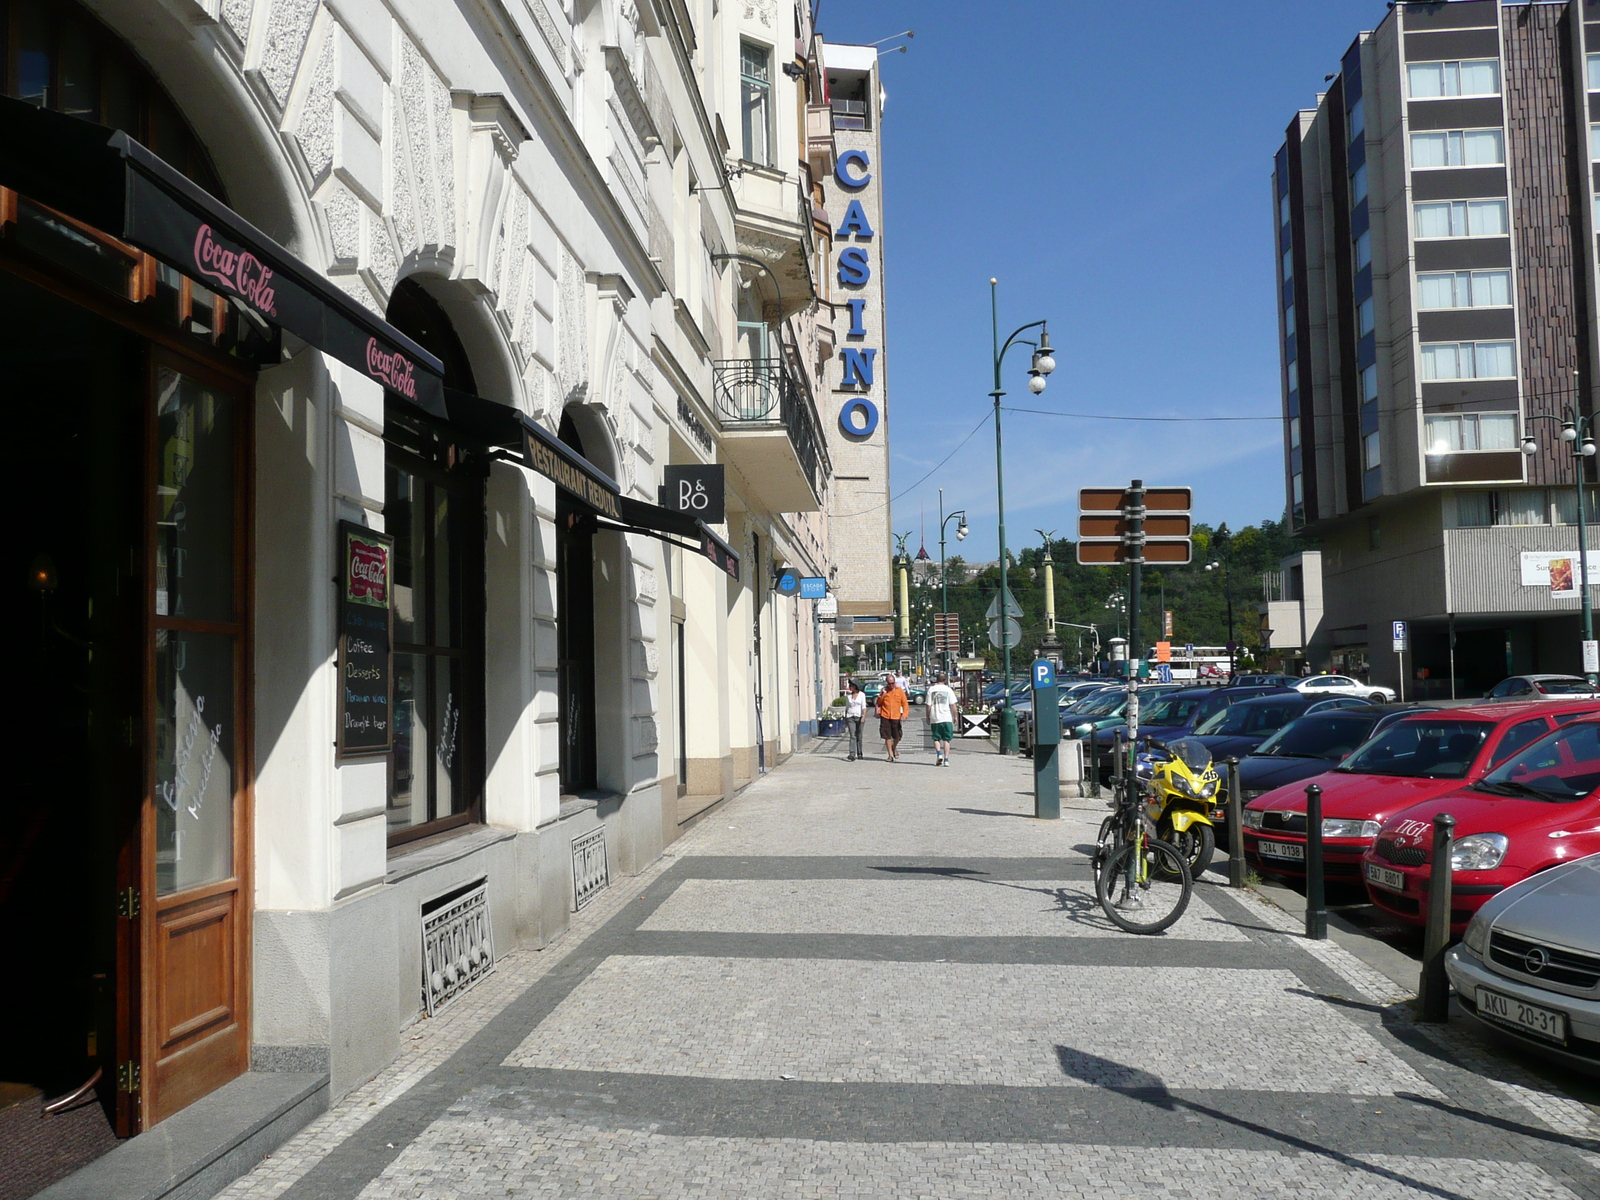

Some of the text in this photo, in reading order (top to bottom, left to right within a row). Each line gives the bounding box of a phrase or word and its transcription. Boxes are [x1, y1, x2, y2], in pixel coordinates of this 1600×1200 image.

[194, 224, 276, 314] Coca-Cola
[836, 150, 879, 436] CASINO
[366, 337, 416, 399] Coca-Cola
[528, 435, 620, 518] RESTAURANT REDUTA
[347, 635, 375, 654] Coffee
[346, 661, 381, 681] Desserts
[1038, 666, 1049, 681] P
[163, 695, 205, 811] Espresso
[188, 723, 222, 820] Macchiato
[1203, 770, 1217, 781] 46
[1395, 819, 1432, 837] TIGI
[1263, 843, 1300, 857] 3A4 0138
[1484, 993, 1508, 1016] AKU
[1517, 1004, 1557, 1034] 20-31
